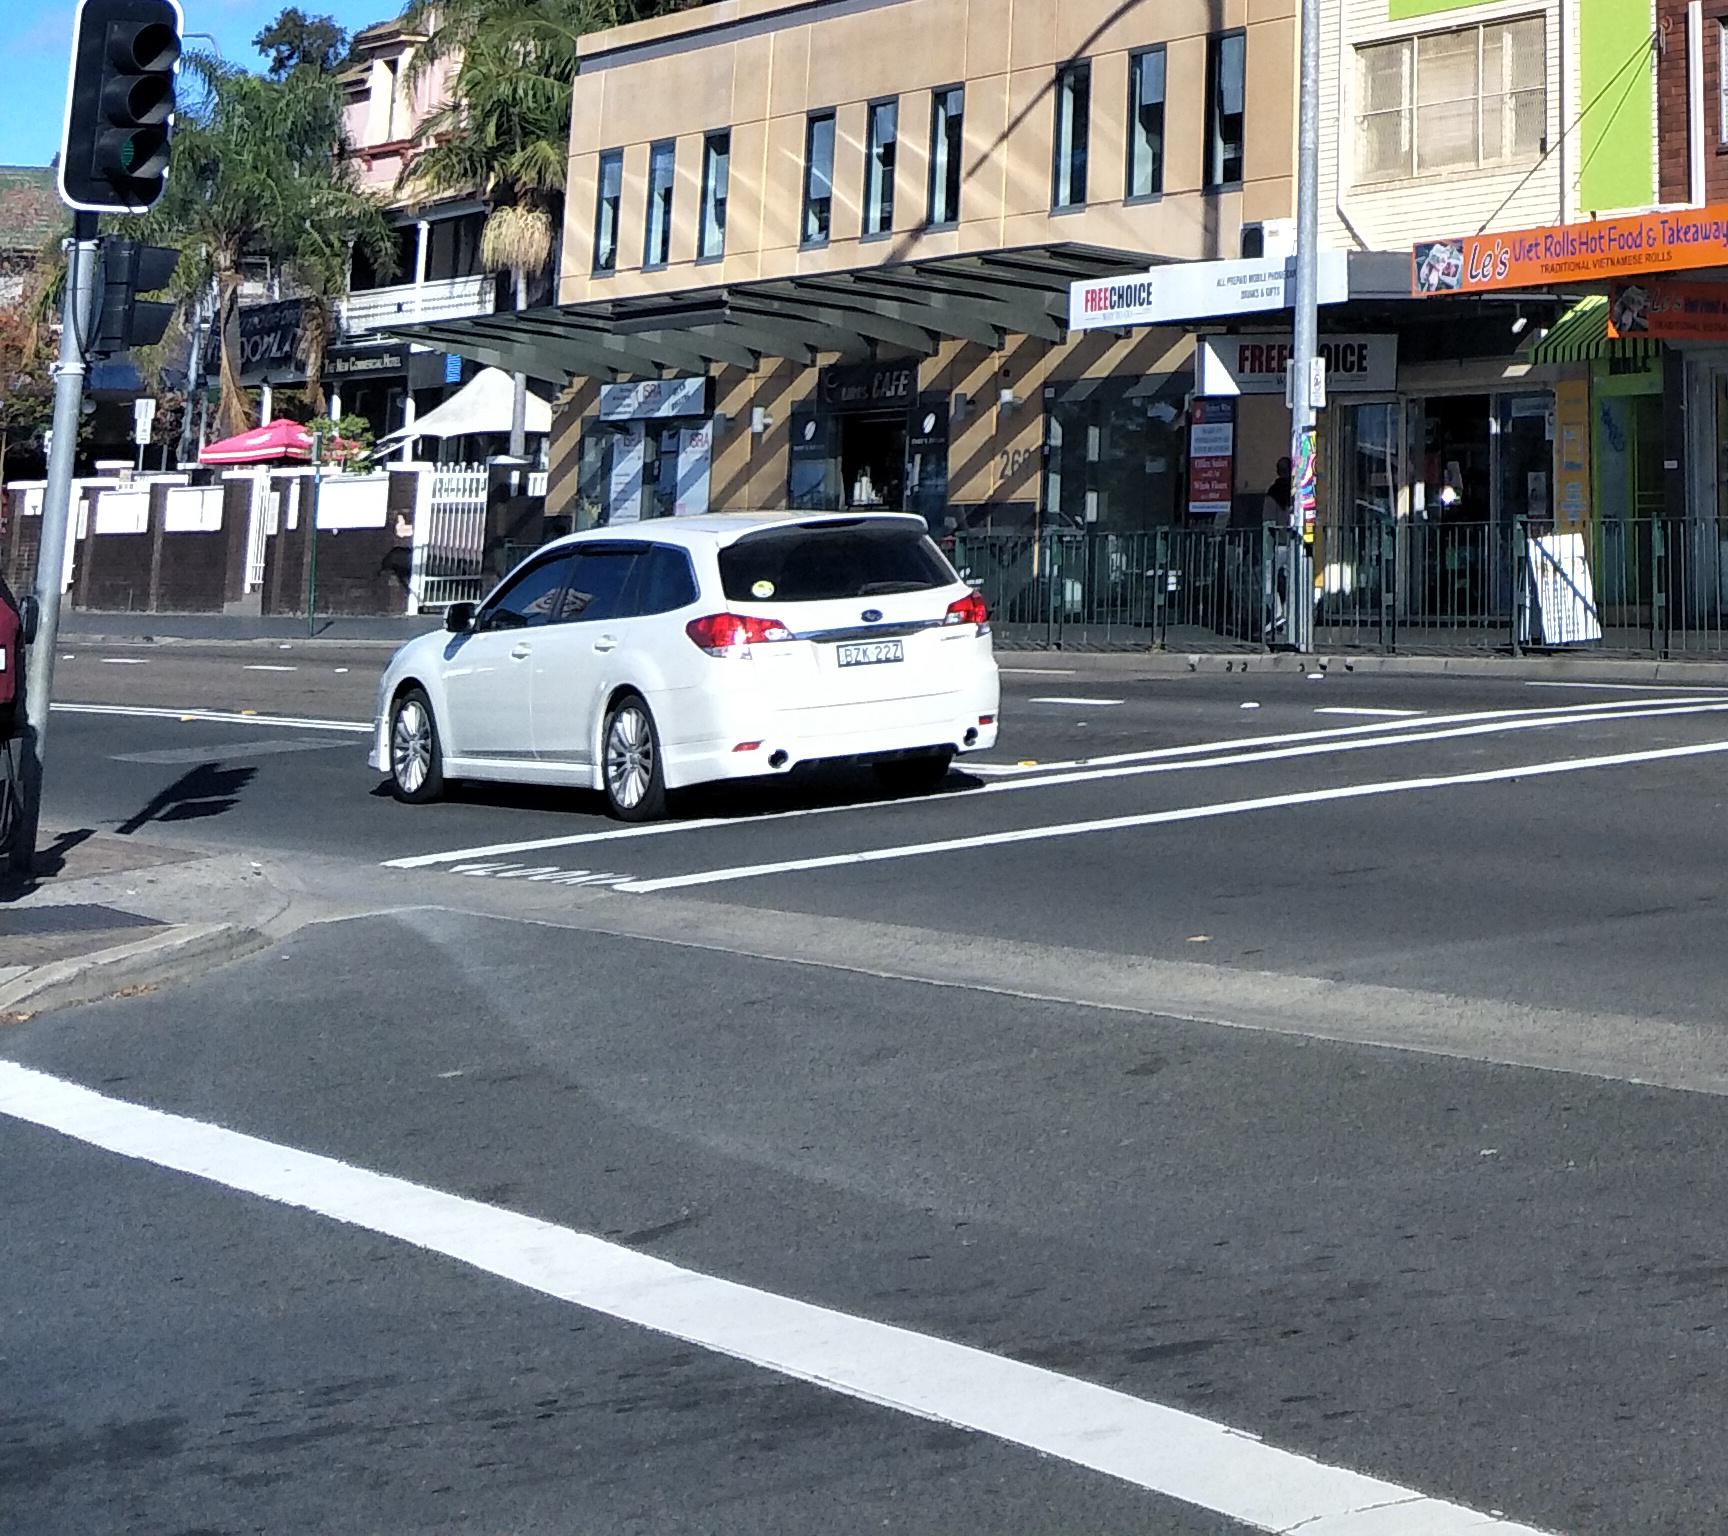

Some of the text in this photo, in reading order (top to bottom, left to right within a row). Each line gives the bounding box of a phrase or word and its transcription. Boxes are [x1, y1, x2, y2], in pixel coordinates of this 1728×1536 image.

[1469, 240, 1510, 281] Le's
[1513, 237, 1540, 261] Viet
[1544, 231, 1577, 258] Rolls
[1608, 222, 1643, 251] Food
[1646, 227, 1656, 247] &
[1660, 217, 1728, 248] Takeaway
[1540, 250, 1673, 274] TRADITIONAL VIETNAMESE ROLLS
[1084, 282, 1153, 313] FREECHOICE
[1238, 342, 1368, 374] FREEOICE
[872, 370, 911, 399] CAFE
